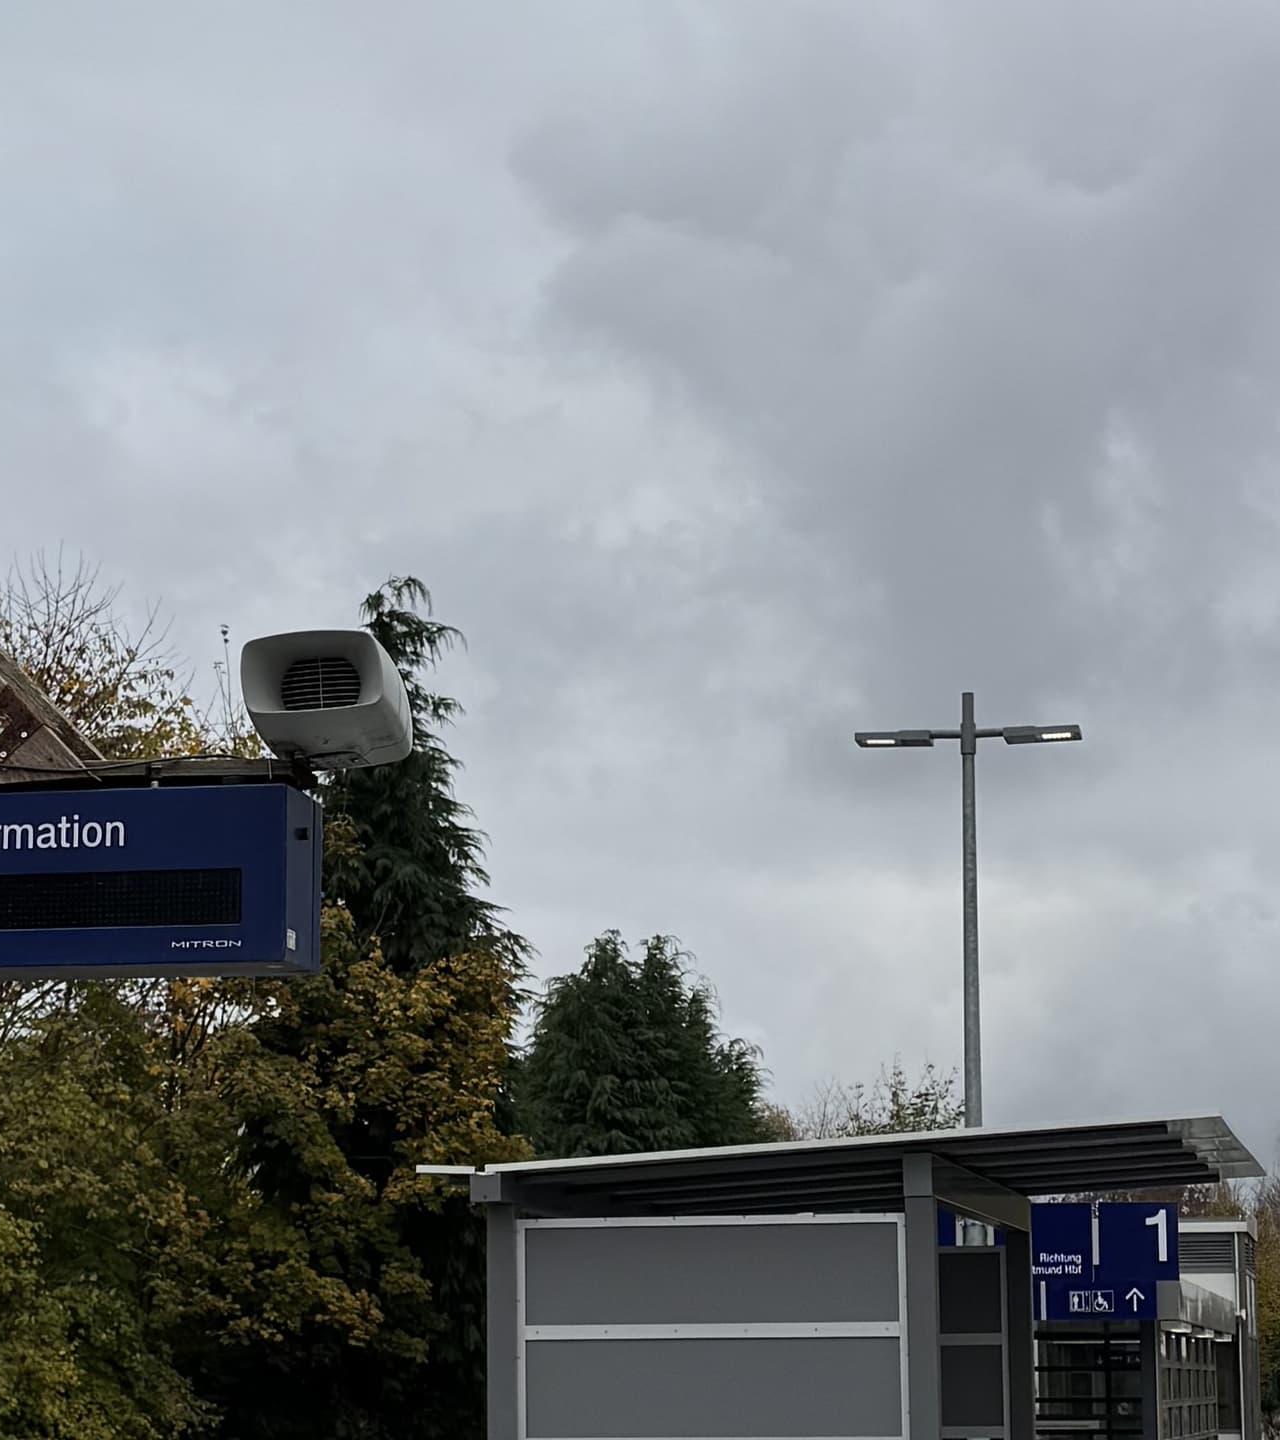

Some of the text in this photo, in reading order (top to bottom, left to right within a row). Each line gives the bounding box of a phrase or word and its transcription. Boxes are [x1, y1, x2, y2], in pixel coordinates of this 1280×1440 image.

[171, 939, 242, 948] MITRON
[1145, 1208, 1168, 1262] 1
[1039, 1252, 1082, 1264] Richtung
[1032, 1264, 1082, 1275] tmund Hbf
